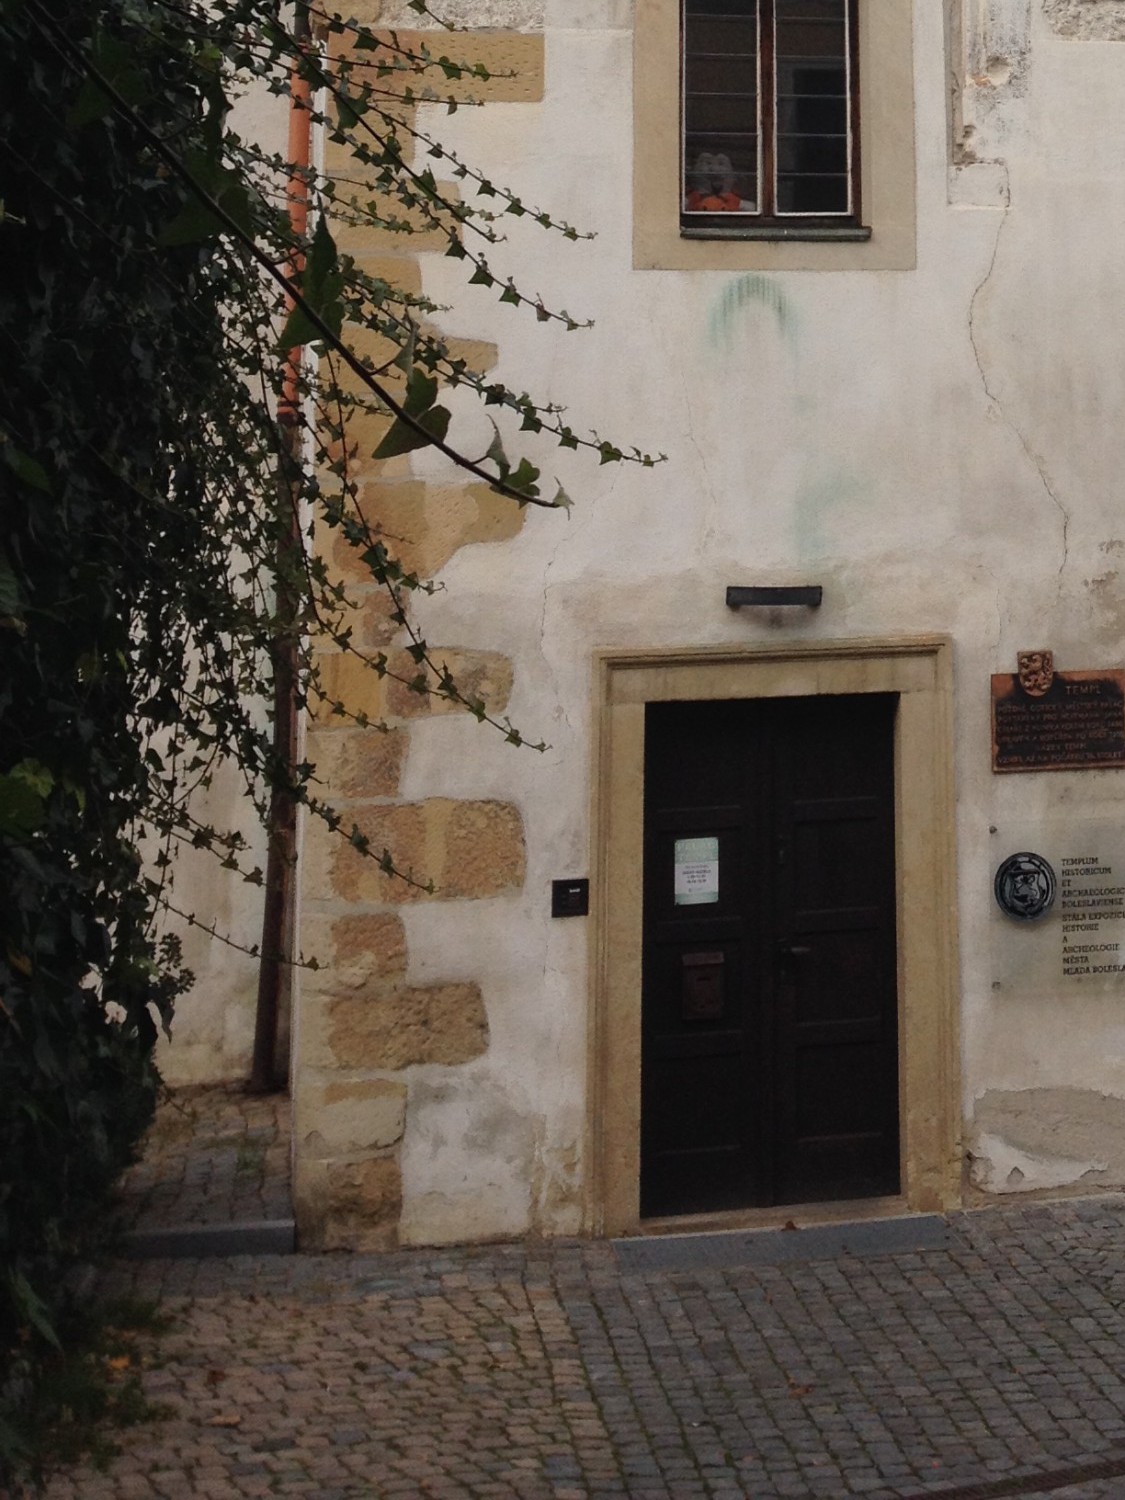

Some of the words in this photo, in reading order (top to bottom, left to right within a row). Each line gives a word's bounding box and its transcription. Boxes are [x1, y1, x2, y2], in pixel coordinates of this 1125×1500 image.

[1065, 685, 1102, 695] TEMPL
[1061, 857, 1099, 866] TEMPLUM
[1061, 867, 1112, 876] HISTORICUM
[1061, 879, 1071, 887] ET
[1062, 923, 1099, 933] HISTORIE
[1062, 935, 1068, 943] A
[1062, 943, 1120, 954] ARCHEOLOGIE
